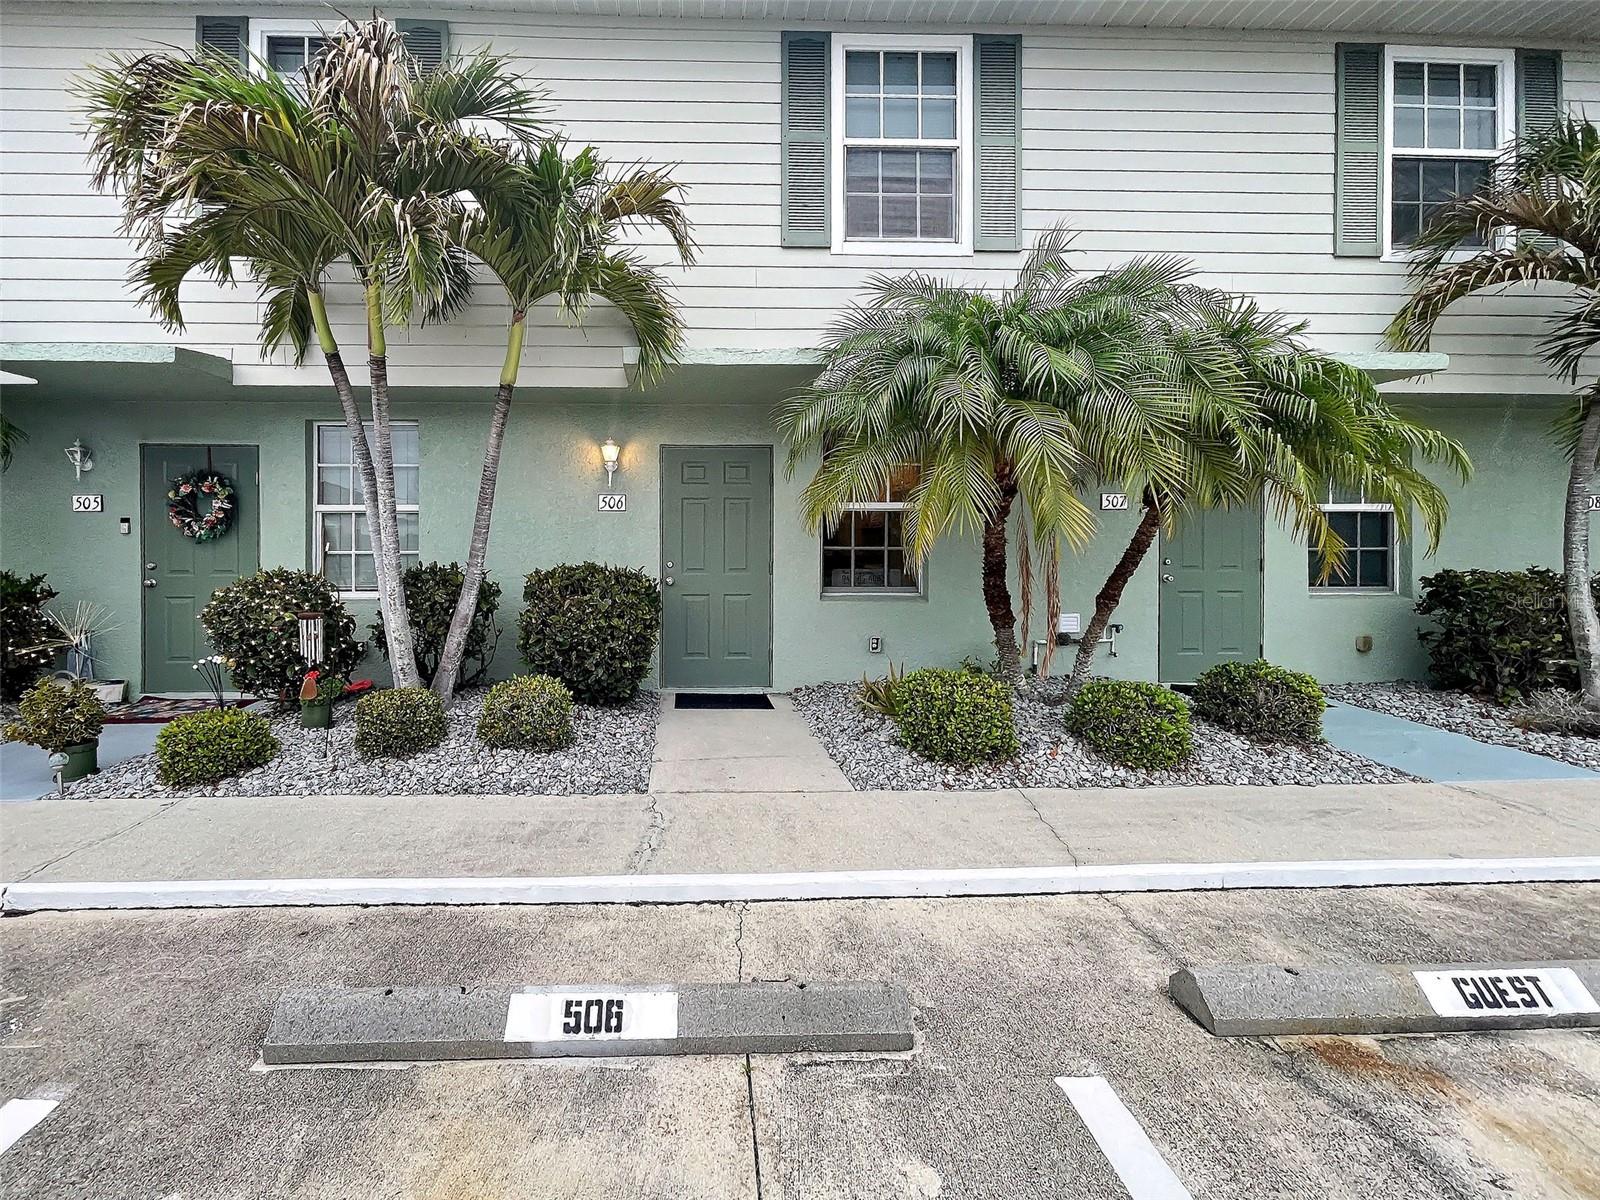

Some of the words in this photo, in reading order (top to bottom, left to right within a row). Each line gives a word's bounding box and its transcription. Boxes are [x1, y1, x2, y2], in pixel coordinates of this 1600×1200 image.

[74, 496, 100, 511] 505
[599, 495, 624, 510] 506
[1103, 495, 1128, 508] 507
[1451, 975, 1554, 1010] GUEST
[562, 998, 625, 1035] 506
